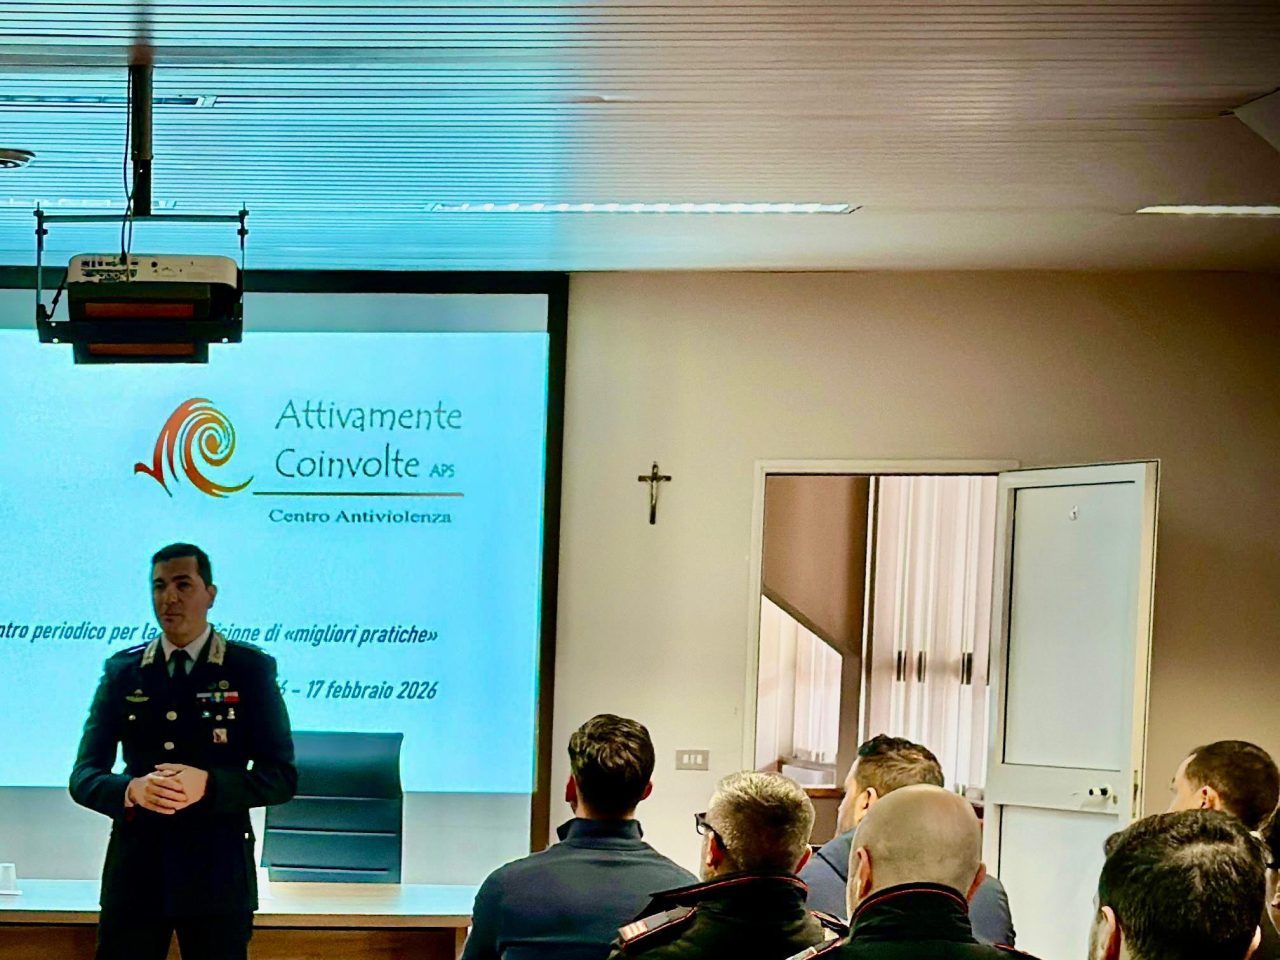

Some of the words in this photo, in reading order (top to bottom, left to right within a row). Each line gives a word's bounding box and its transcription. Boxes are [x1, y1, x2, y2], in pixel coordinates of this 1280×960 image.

[275, 399, 462, 431] Attivamente
[275, 442, 420, 479] Coinvolte
[429, 463, 455, 479] APS
[269, 508, 330, 524] Centro
[335, 509, 452, 524] Antiviolenza
[30, 620, 106, 643] periodico
[108, 624, 140, 645] per
[142, 622, 158, 641] la
[264, 622, 283, 643] di
[284, 623, 360, 647] «migliori
[357, 624, 439, 648] pratiche»
[306, 679, 326, 699] 17
[324, 679, 394, 699] febbraio
[396, 681, 440, 700] 2026
